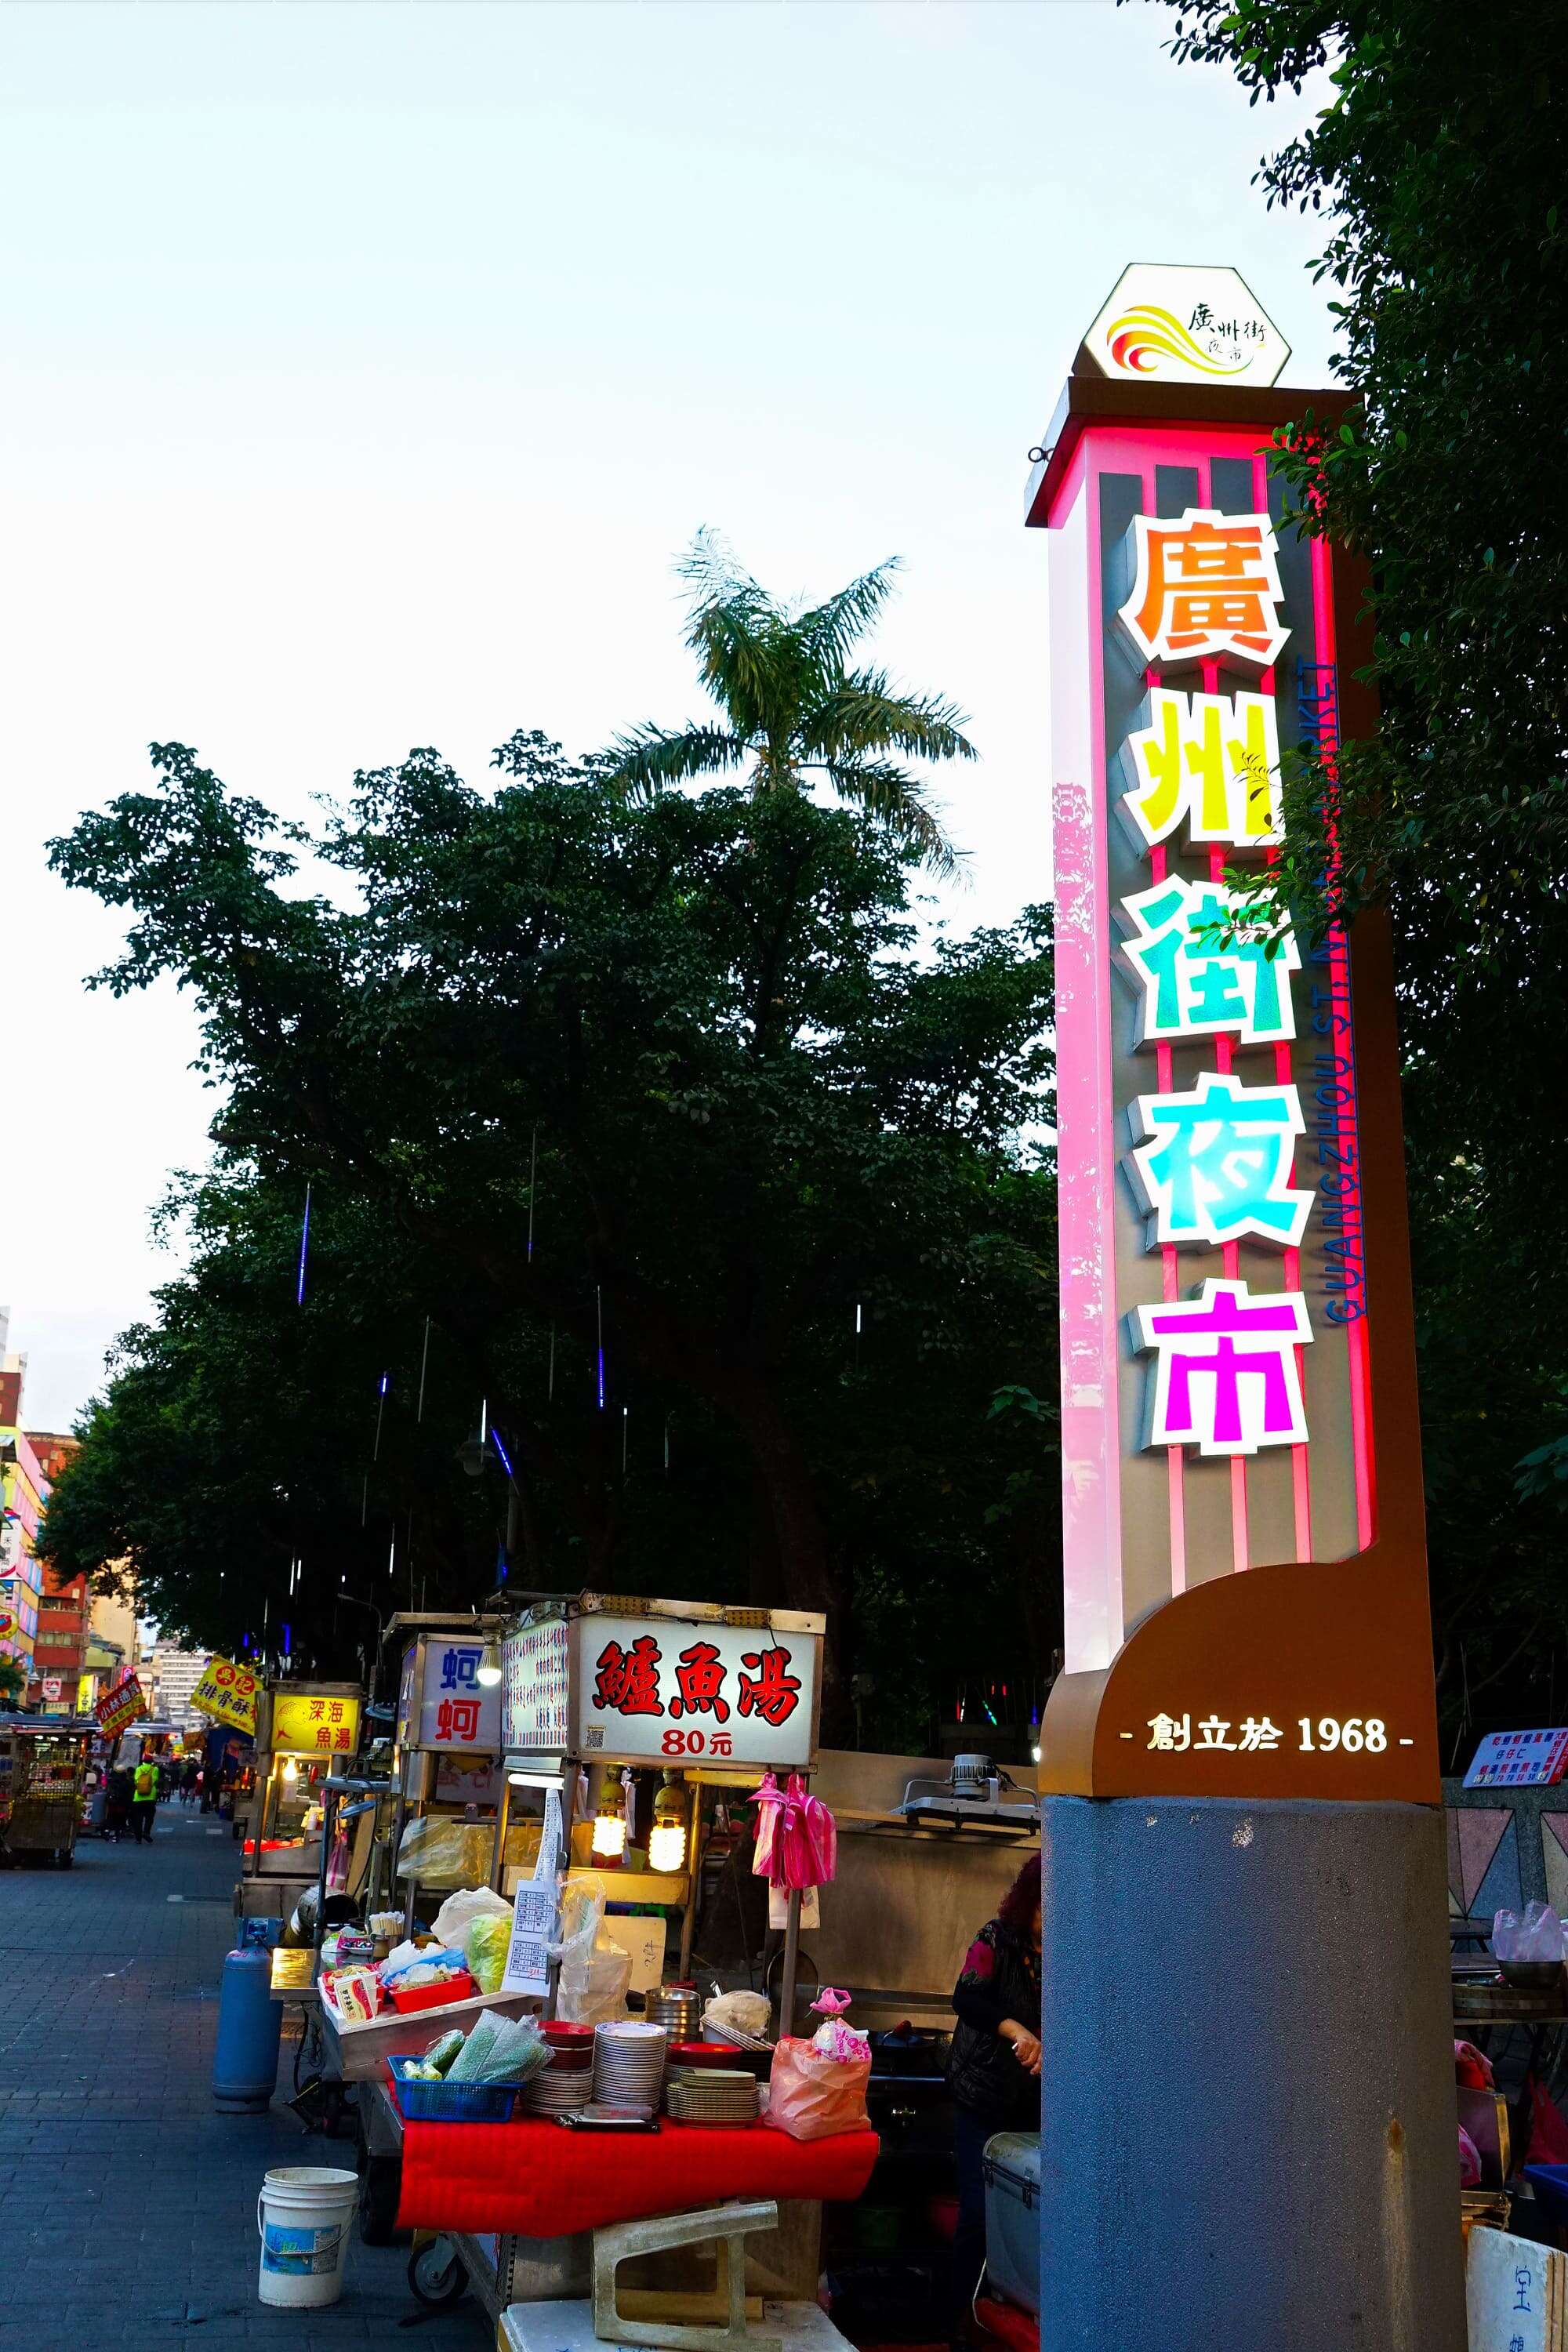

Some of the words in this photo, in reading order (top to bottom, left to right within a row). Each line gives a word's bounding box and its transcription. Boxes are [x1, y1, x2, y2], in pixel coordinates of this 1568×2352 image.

[1189, 303, 1266, 341] 廣州街
[1208, 339, 1242, 362] 夜市
[1119, 507, 1316, 1456] 廣州街夜市
[1315, 1054, 1363, 1323] GUANGZHOU
[592, 1635, 801, 1726] 鱸魚湯
[309, 1700, 343, 1722] 深海
[435, 1698, 481, 1740] 蚵
[315, 1727, 350, 1749] 魚湯
[661, 1730, 732, 1756] 80元
[1147, 1713, 1283, 1751] 創立於
[1298, 1717, 1387, 1752] 1968
